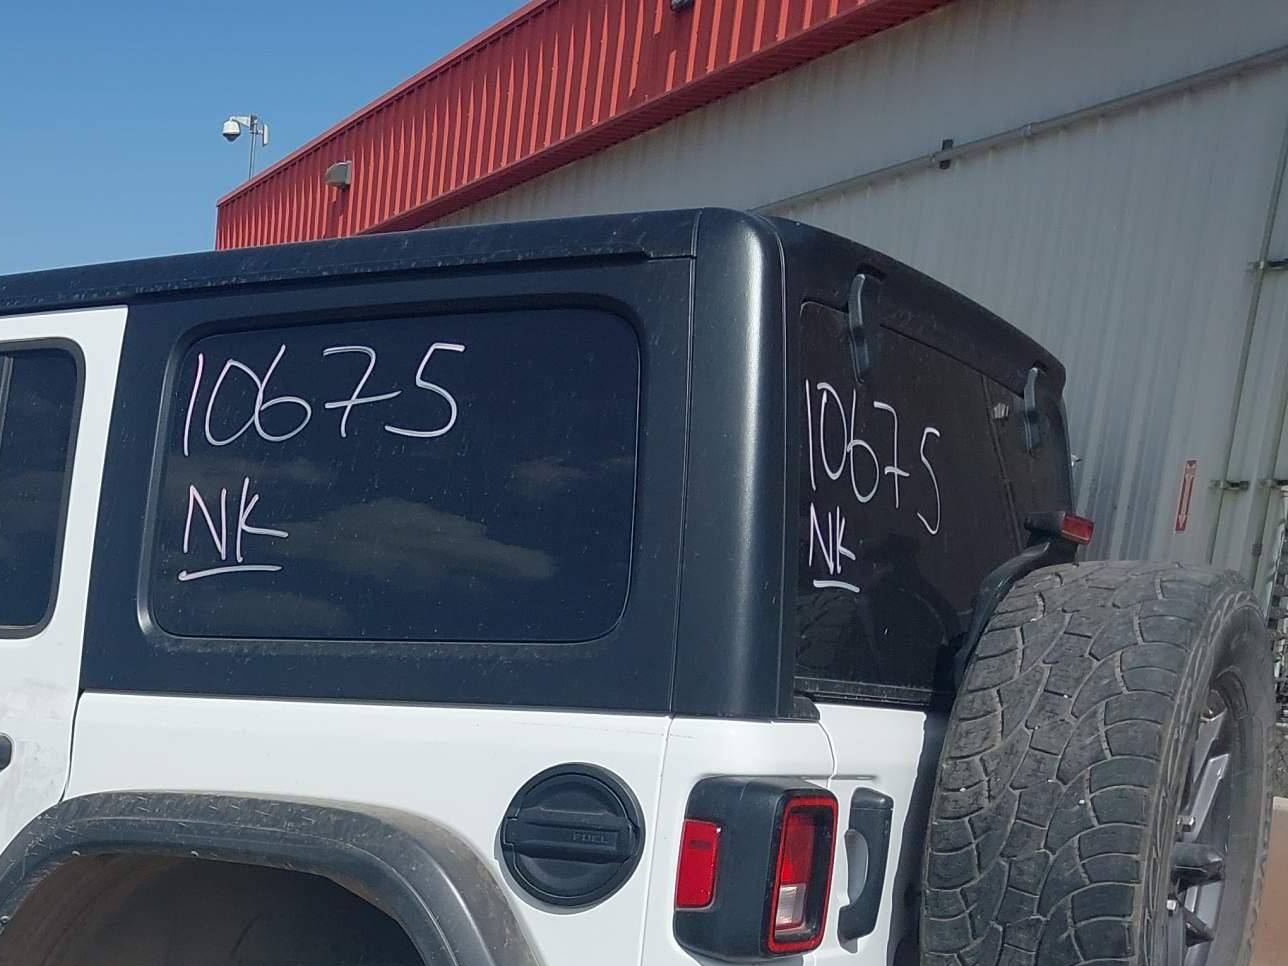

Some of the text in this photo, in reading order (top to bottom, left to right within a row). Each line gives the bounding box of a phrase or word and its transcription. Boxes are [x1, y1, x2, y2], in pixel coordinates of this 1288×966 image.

[183, 343, 466, 457] 10675
[805, 379, 941, 535] 10675
[183, 477, 289, 563] NK
[808, 502, 857, 575] NK
[572, 831, 608, 845] FUEL
